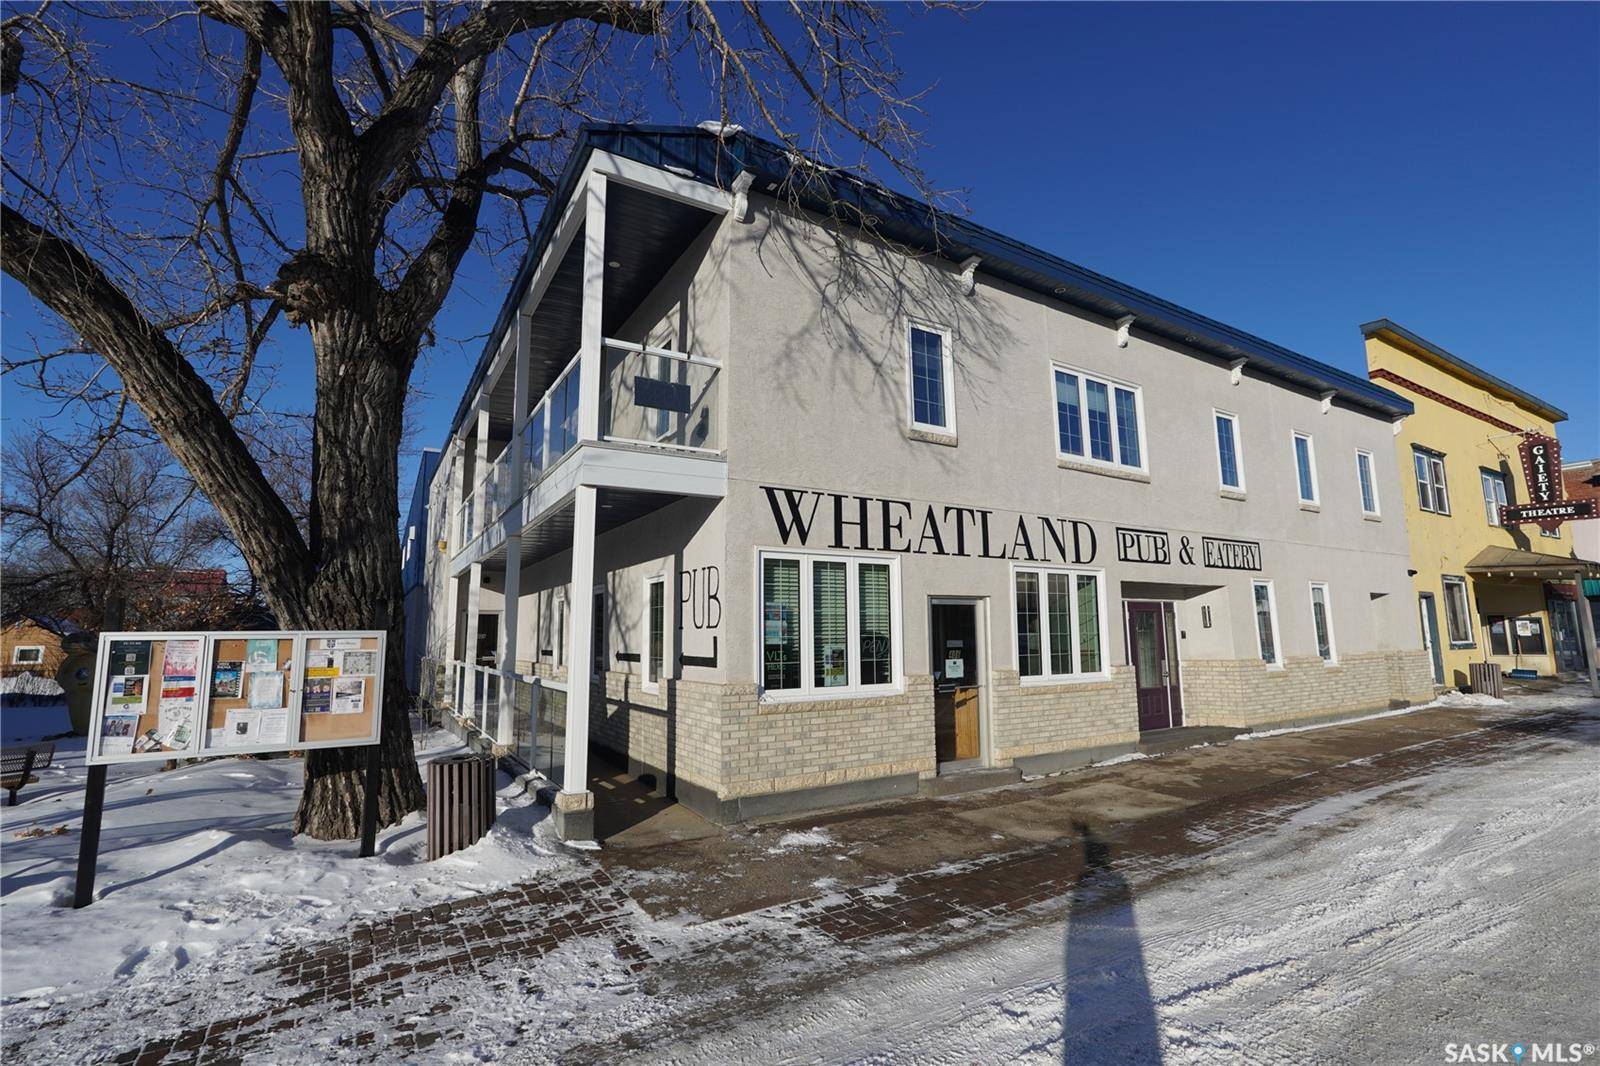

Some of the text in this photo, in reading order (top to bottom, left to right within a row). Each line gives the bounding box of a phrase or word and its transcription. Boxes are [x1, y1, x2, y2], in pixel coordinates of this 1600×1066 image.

[1532, 445, 1550, 501] GAIETY
[759, 485, 1258, 570] WHEATLAND PUB & EATERY
[1520, 506, 1575, 518] THEATRE
[678, 565, 722, 630] PUB
